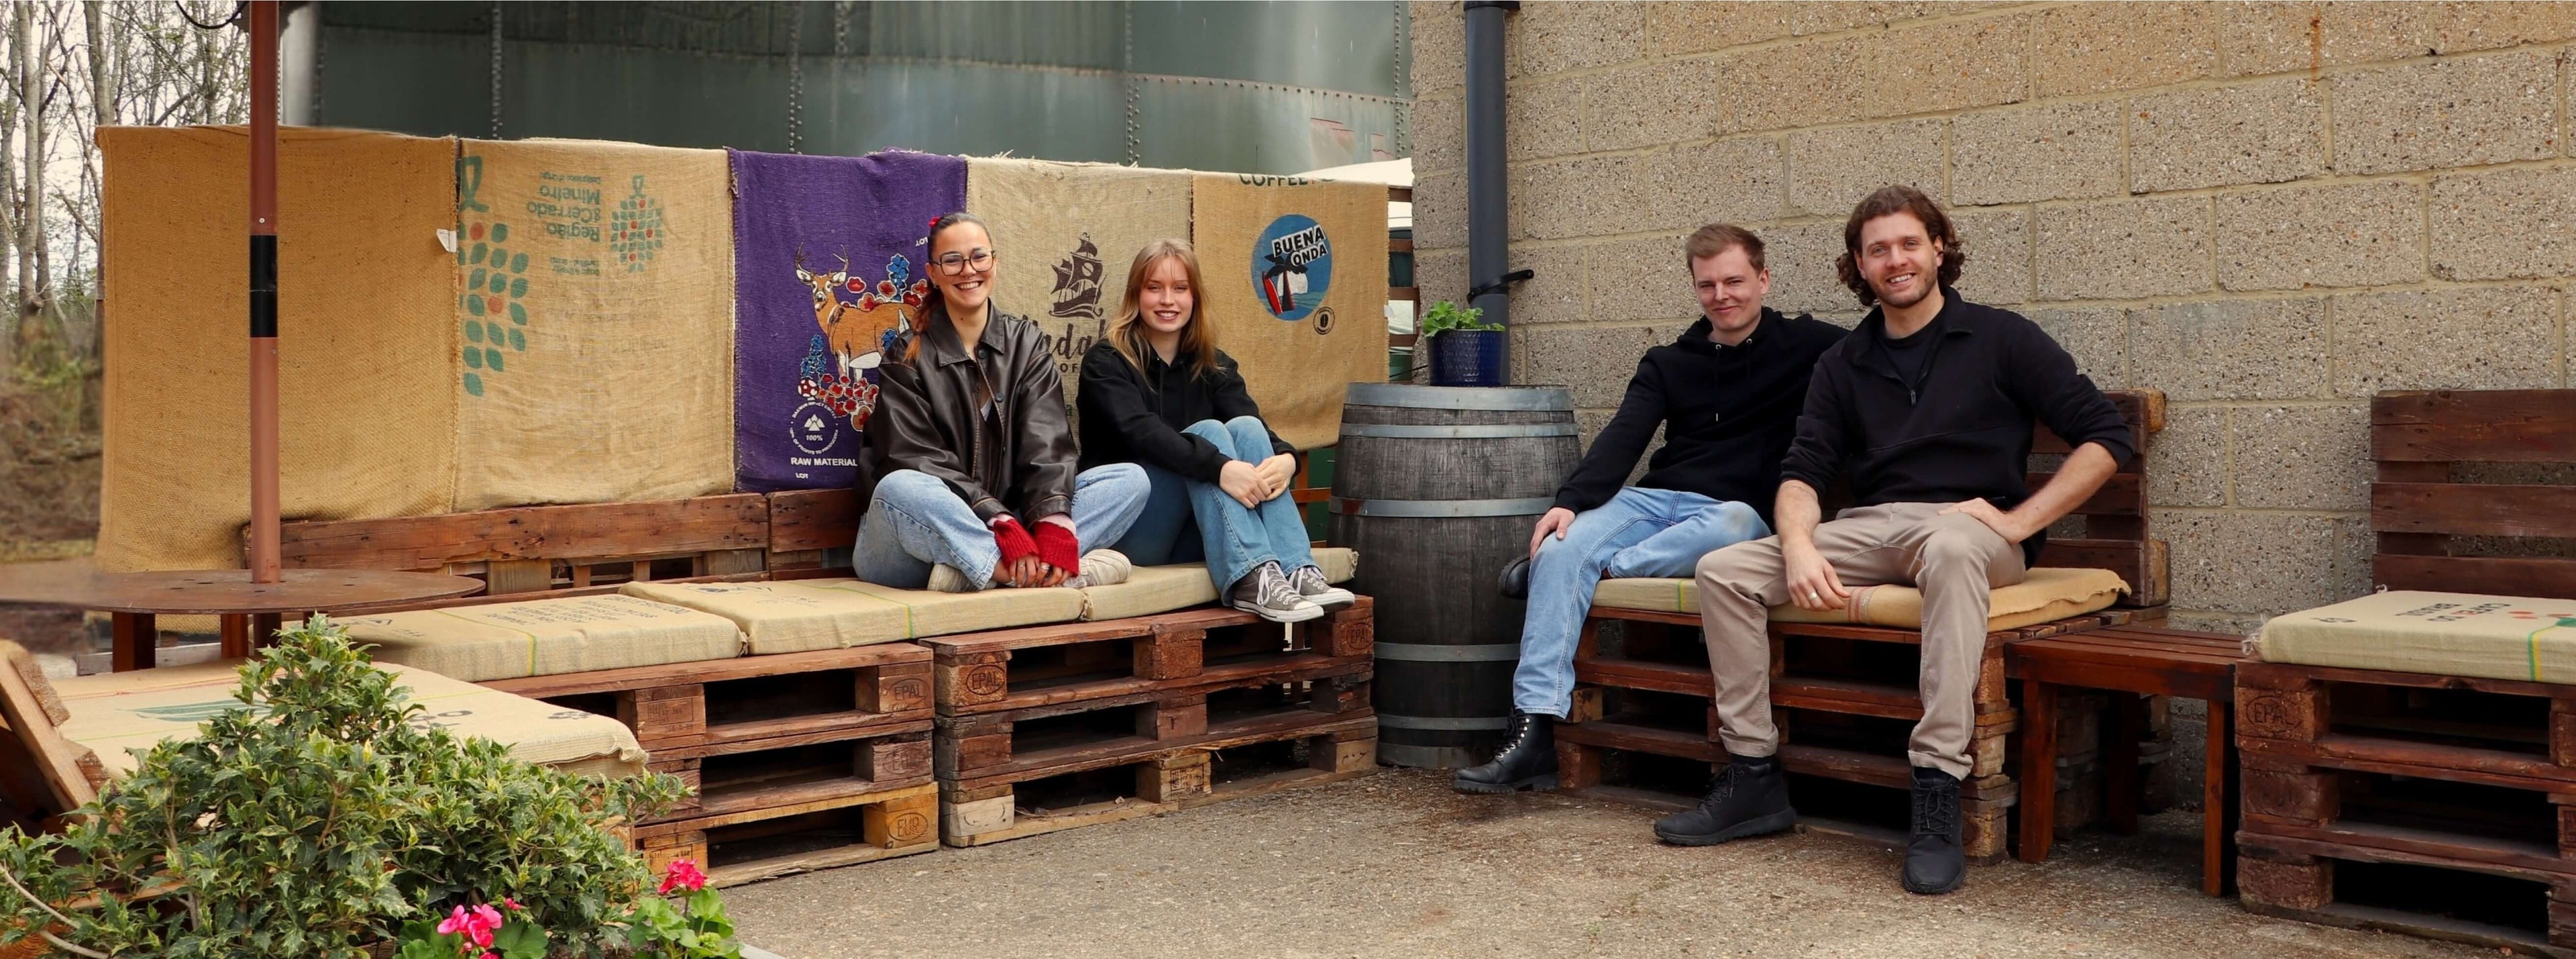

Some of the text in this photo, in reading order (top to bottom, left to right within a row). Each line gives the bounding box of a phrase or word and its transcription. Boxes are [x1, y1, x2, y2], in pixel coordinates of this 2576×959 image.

[539, 185, 600, 205] Mineiro
[546, 221, 600, 242] Região
[915, 236, 928, 247] LOT
[1273, 226, 1325, 257] BUENA
[1292, 243, 1328, 266] ONDA
[790, 457, 858, 467] RAW MATERIAL
[1350, 628, 1371, 644] EPAL
[973, 671, 1000, 690] EPAL
[894, 684, 924, 701] EPAL
[2254, 703, 2294, 725] EPAL
[897, 817, 920, 838] EUR
